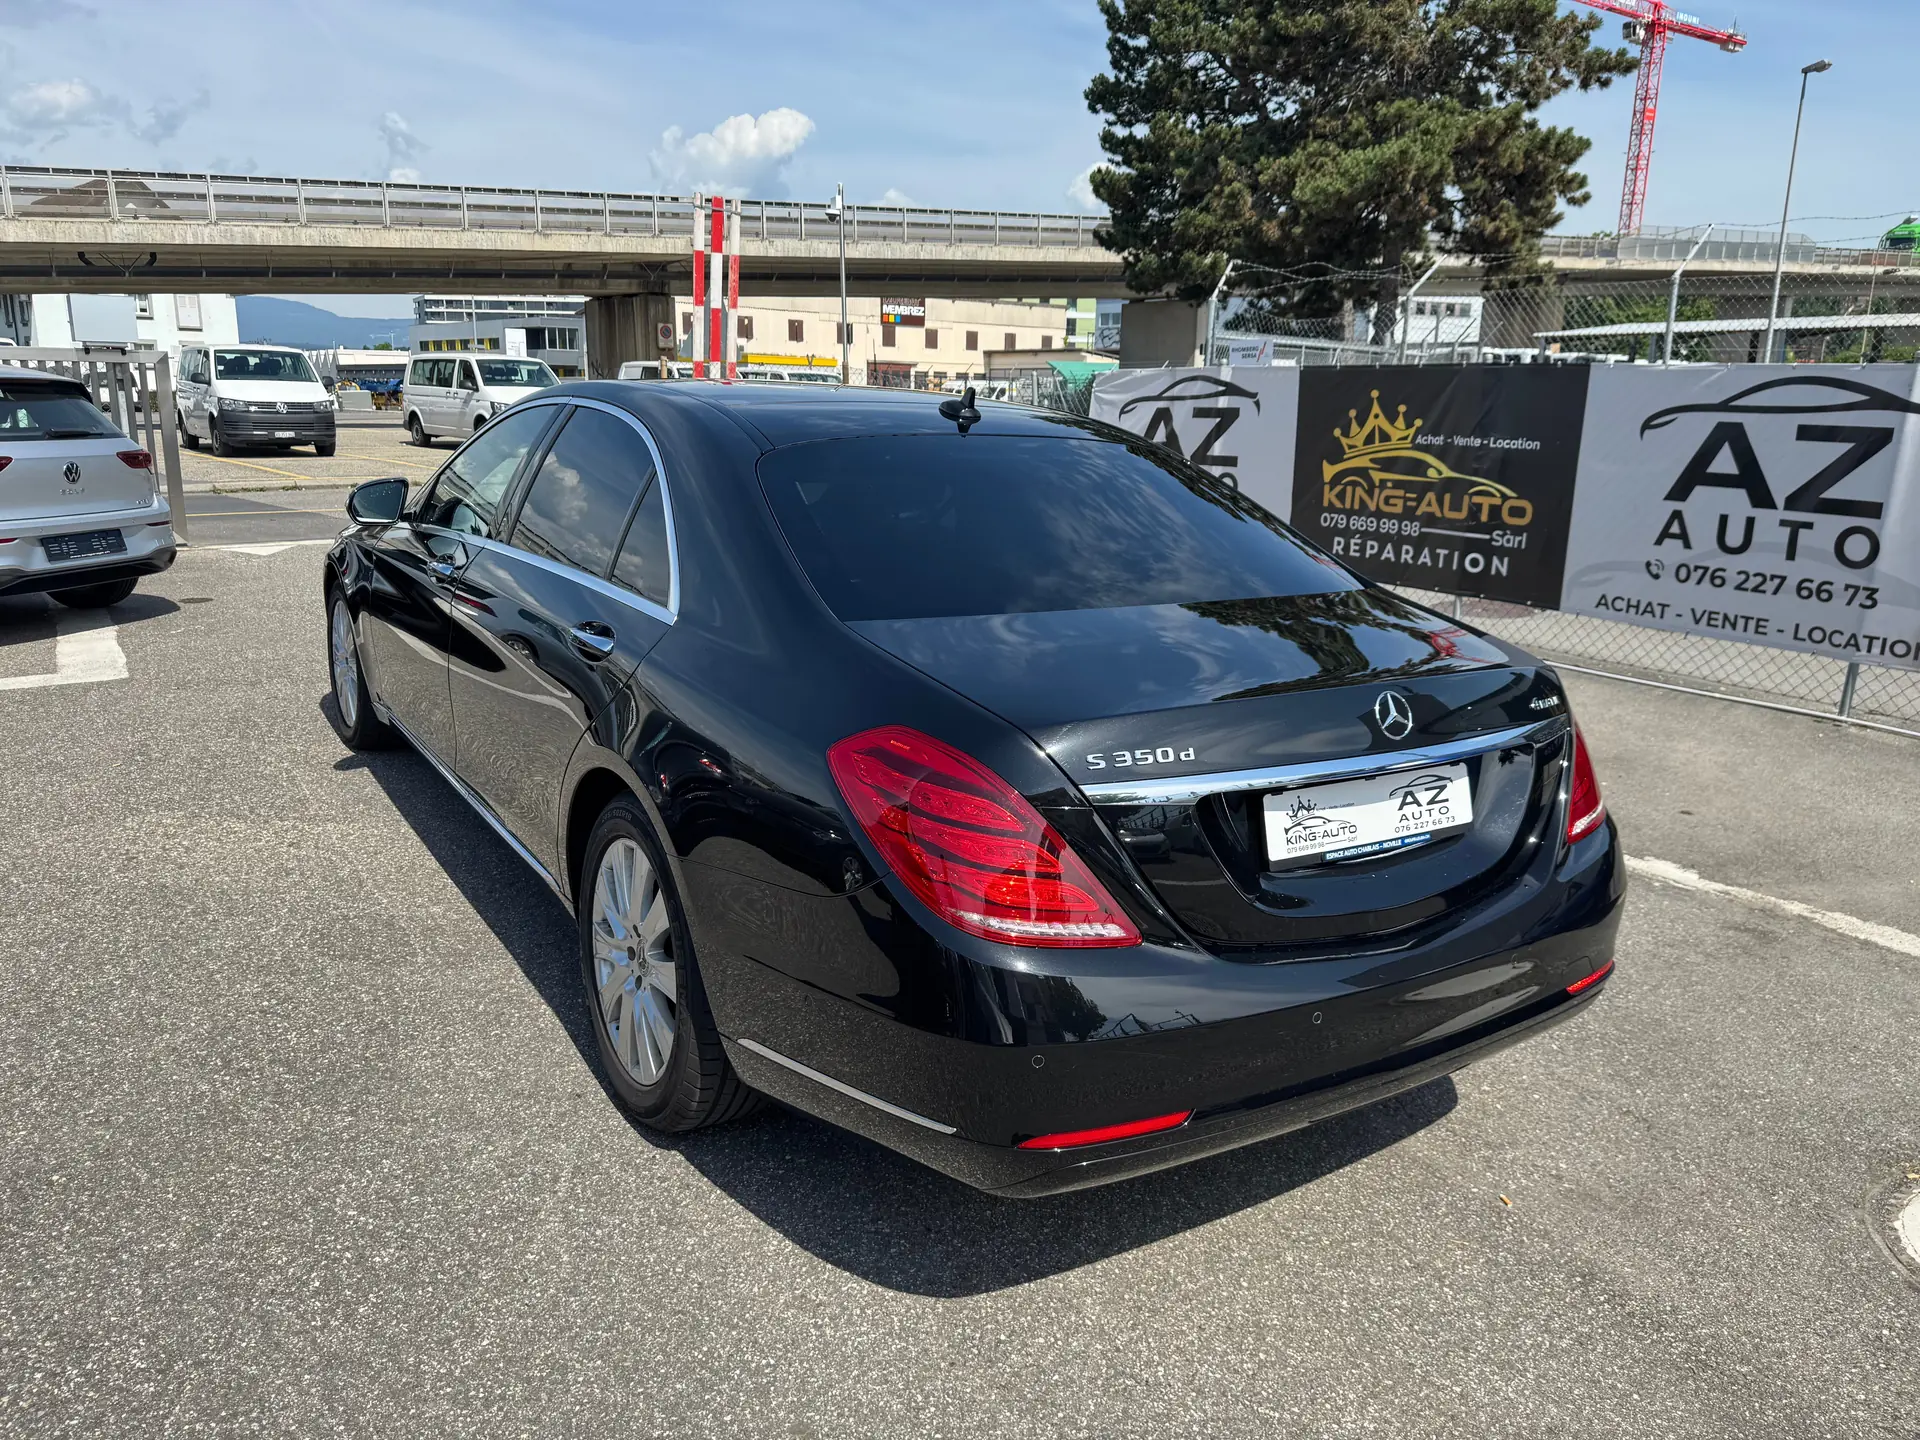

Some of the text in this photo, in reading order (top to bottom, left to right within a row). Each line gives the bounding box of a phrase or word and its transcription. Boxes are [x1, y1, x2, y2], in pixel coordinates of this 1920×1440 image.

[883, 304, 924, 316] MEMBREZ
[1242, 352, 1257, 360] SERSA
[1416, 434, 1444, 446] Achat
[1453, 434, 1481, 447] Vente
[1490, 437, 1540, 450] Location
[1663, 421, 1894, 520] AZ
[1320, 512, 1527, 549] 079 669 99 98 Sàrl
[1653, 509, 1880, 570] AUTO
[1332, 535, 1508, 576] RÉPARATION
[1675, 563, 1880, 610] 076 227 66 73
[1595, 594, 1670, 620] ACHAT
[1690, 608, 1770, 636] VENTE
[1086, 747, 1195, 770] S 350 d
[1398, 784, 1449, 811] AZ
[1395, 824, 1410, 833] 076
[1414, 821, 1429, 830] 227
[1432, 818, 1442, 826] 66
[1399, 806, 1449, 823] AUTO
[1287, 846, 1298, 854] 079
[1298, 844, 1310, 852] 669
[1326, 850, 1344, 860] ESPACE
[1344, 848, 1357, 856] AUTO
[1357, 844, 1380, 854] CHABLAIS
[1383, 839, 1401, 848] NOVILLE
